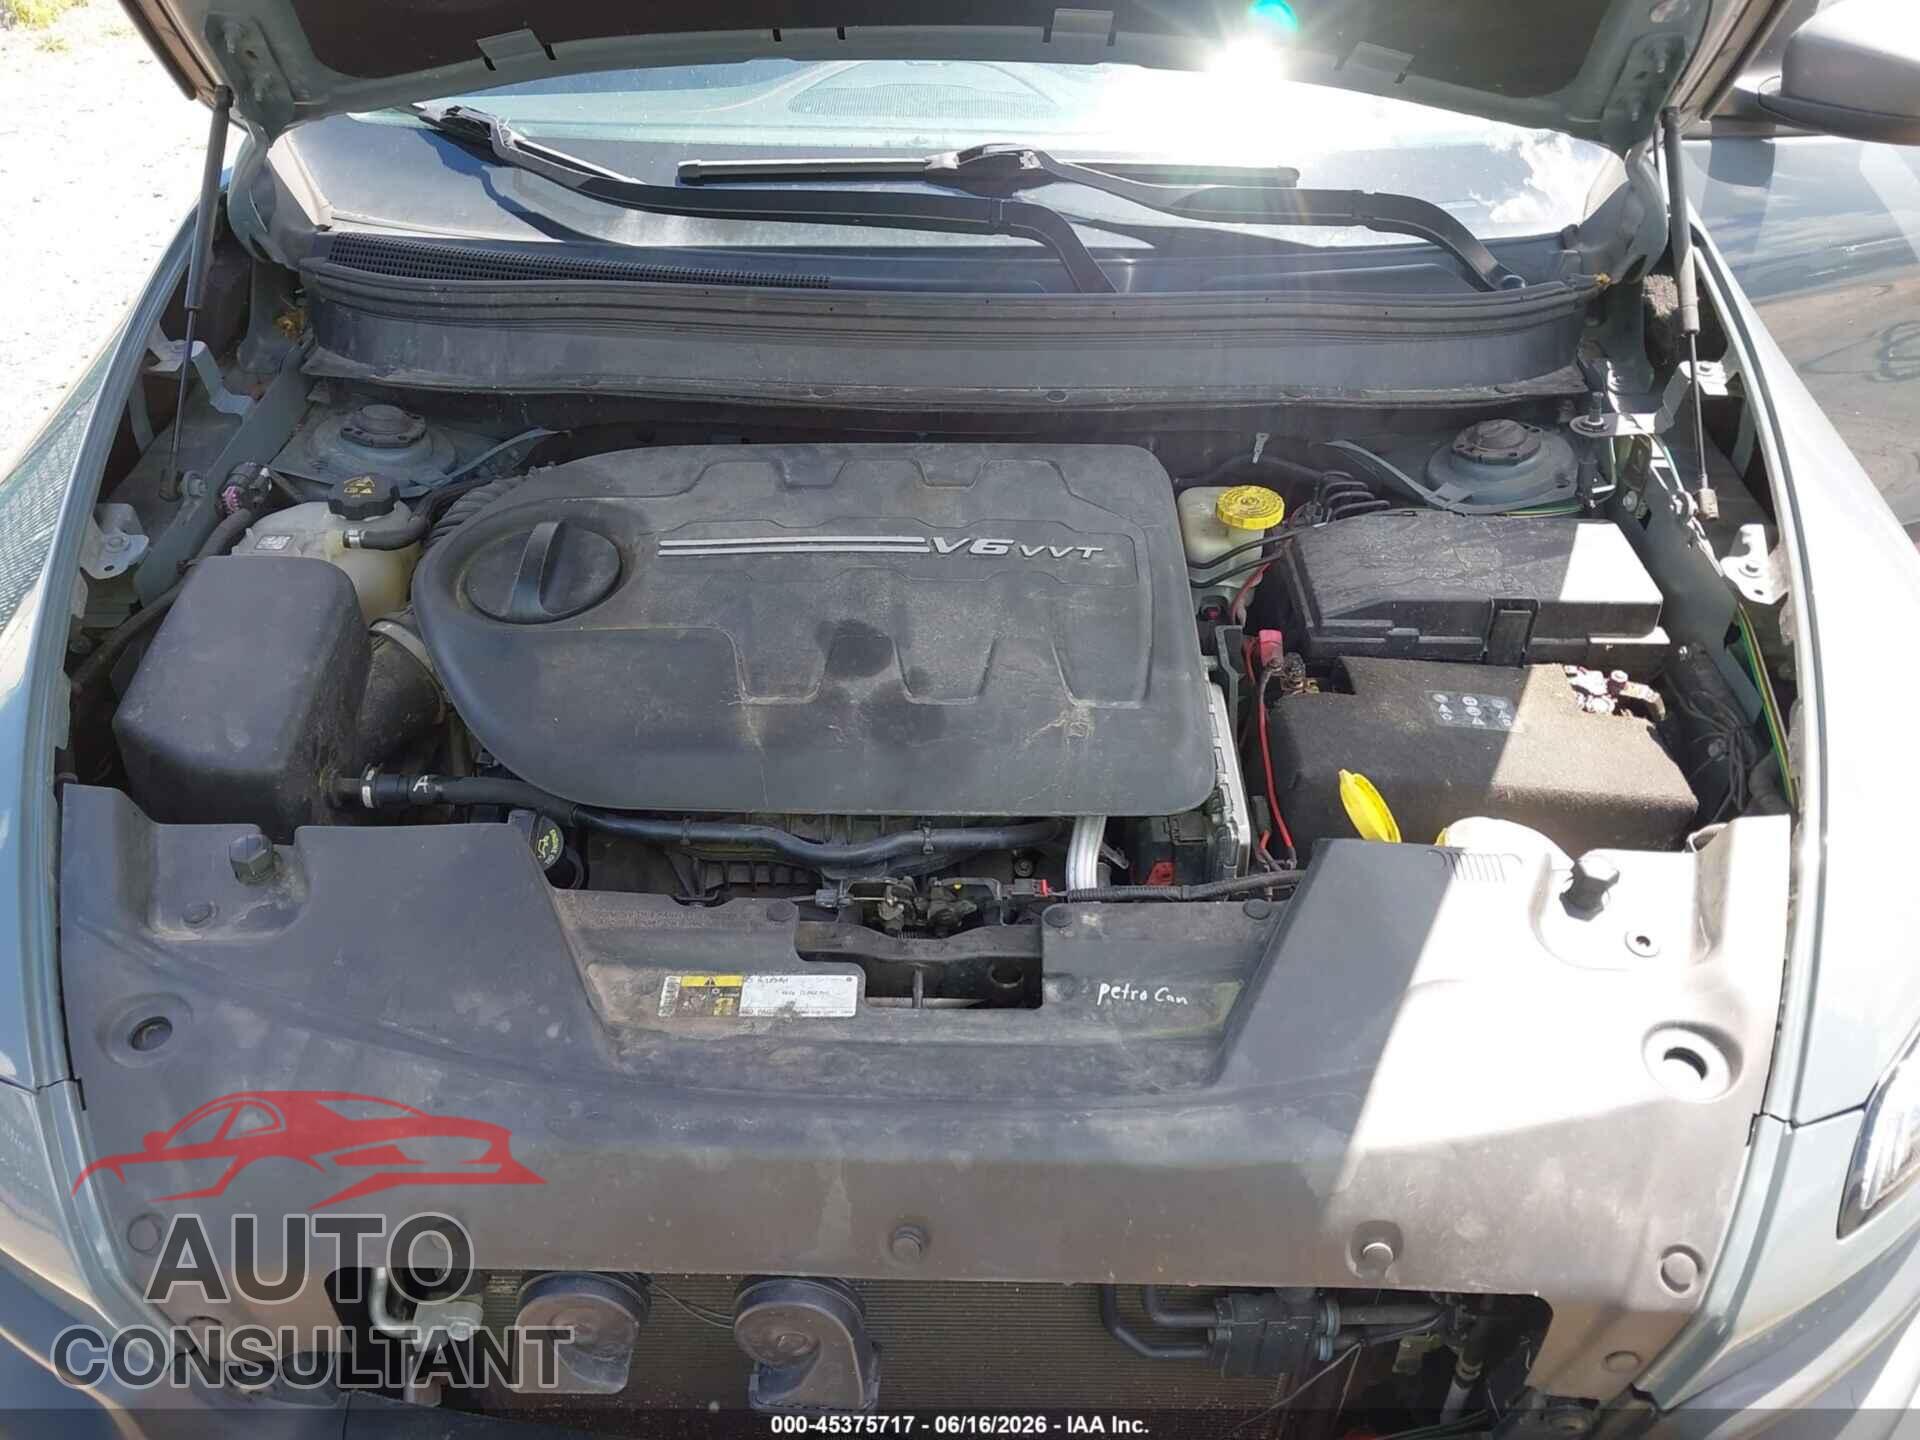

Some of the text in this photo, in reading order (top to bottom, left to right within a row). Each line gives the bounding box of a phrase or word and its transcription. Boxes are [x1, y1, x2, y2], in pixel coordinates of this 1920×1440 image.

[933, 536, 1103, 558] V6 VVT
[1154, 986, 1188, 1005] Can
